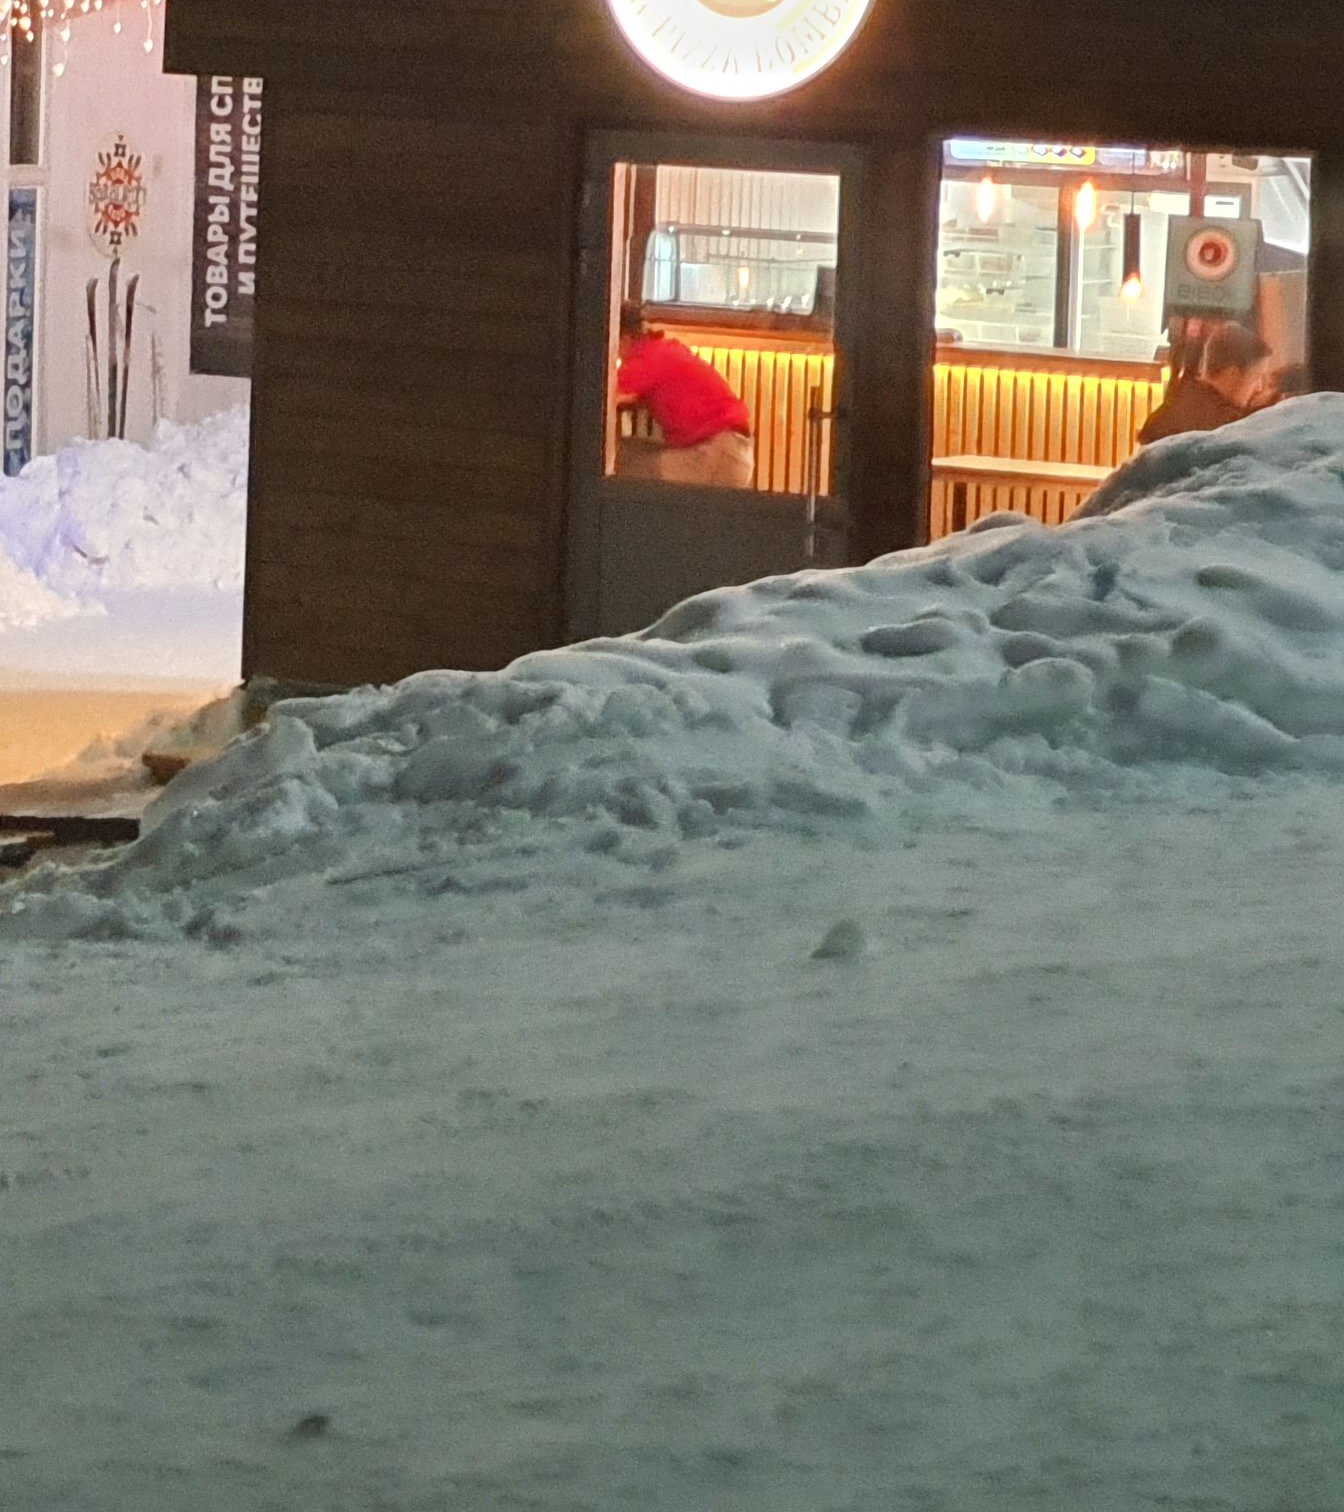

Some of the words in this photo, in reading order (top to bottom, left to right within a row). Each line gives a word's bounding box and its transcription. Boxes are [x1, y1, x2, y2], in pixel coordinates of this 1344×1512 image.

[208, 123, 234, 191] ДЛЯ
[205, 195, 231, 327] ТОВАРЫ
[238, 272, 255, 294] И
[6, 229, 30, 450] ПОДАРКИ
